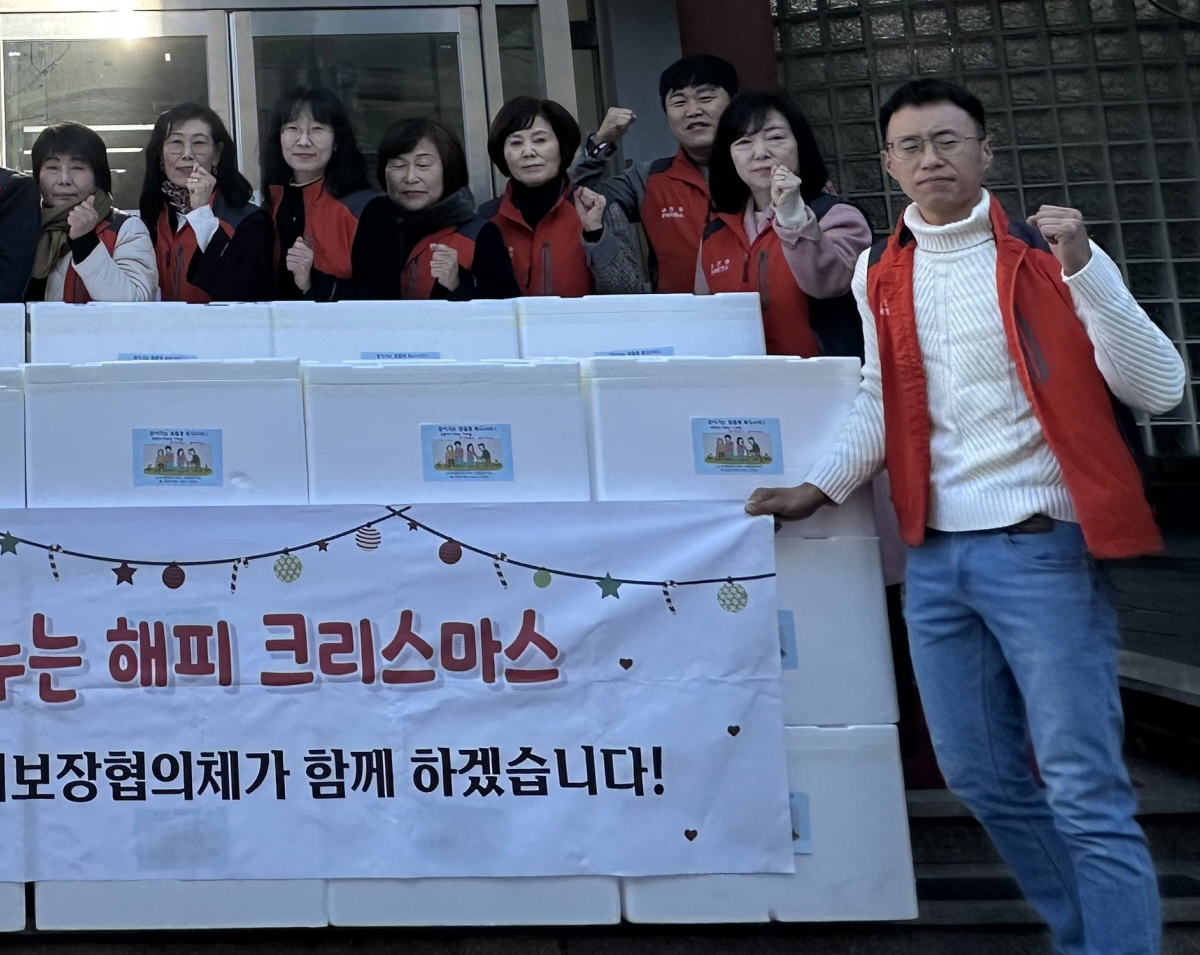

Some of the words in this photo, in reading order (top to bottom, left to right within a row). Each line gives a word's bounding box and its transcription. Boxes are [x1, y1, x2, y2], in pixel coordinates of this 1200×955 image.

[106, 616, 232, 687] 해피
[260, 609, 560, 685] 크리스마스
[304, 748, 395, 800] 함께
[411, 746, 665, 797] 하겠습니다!
